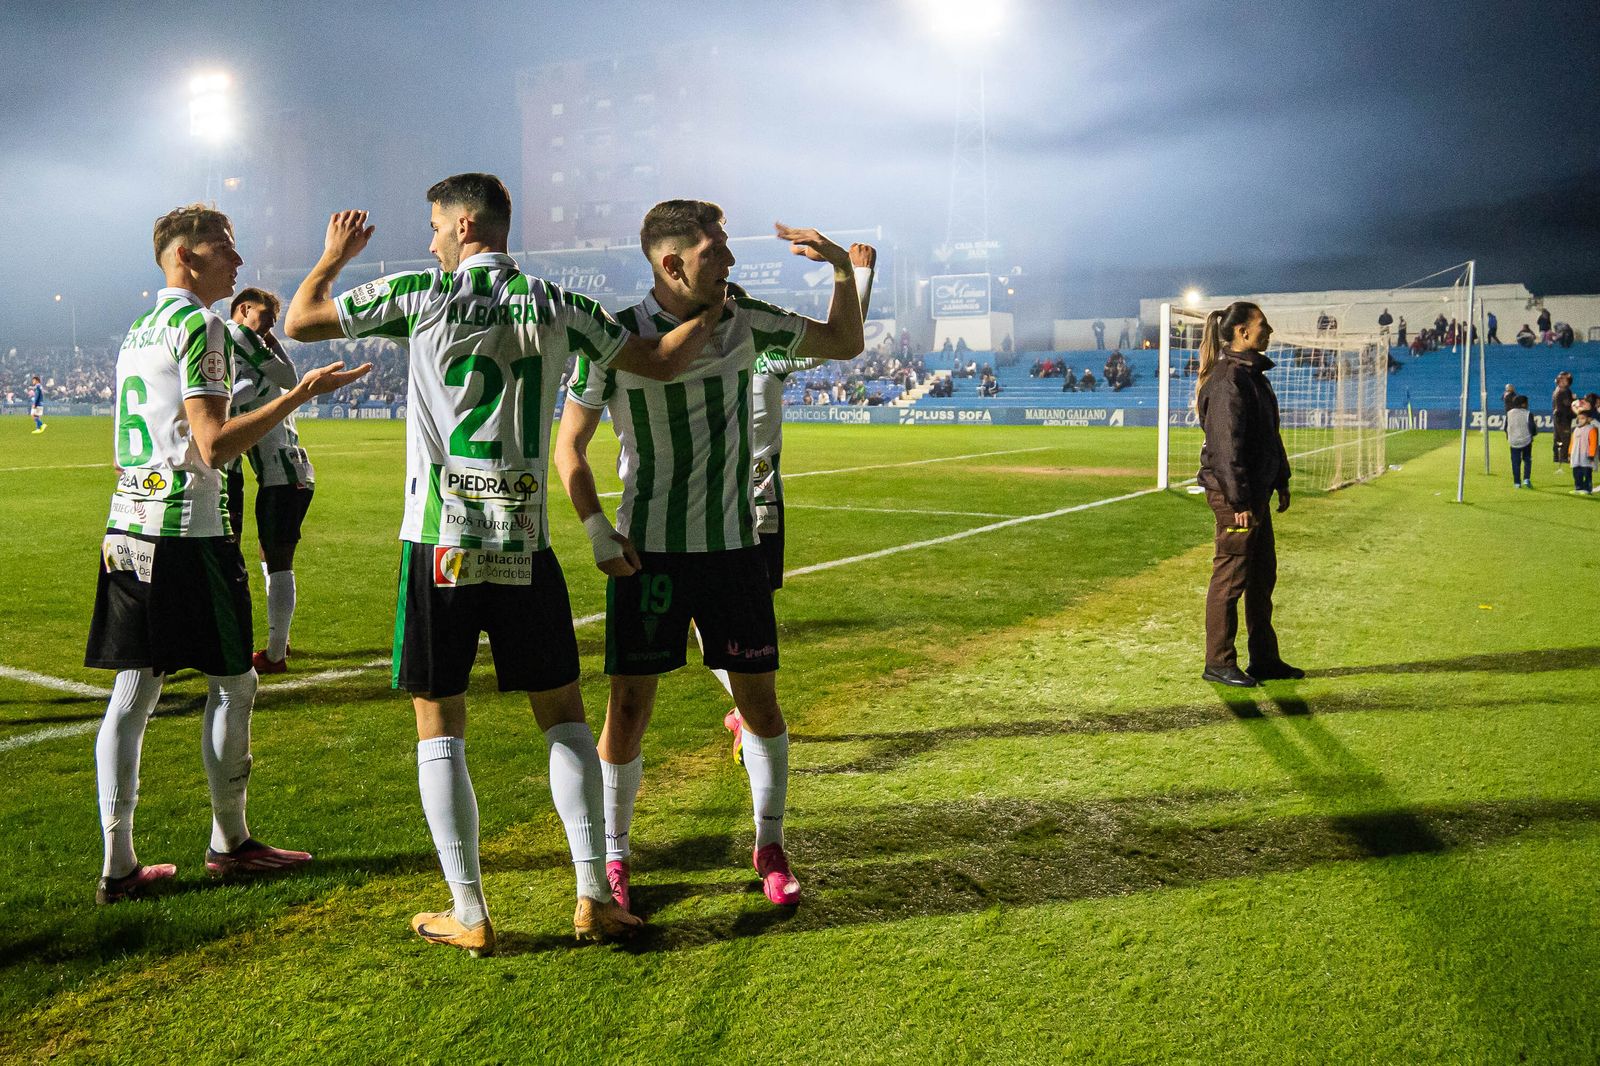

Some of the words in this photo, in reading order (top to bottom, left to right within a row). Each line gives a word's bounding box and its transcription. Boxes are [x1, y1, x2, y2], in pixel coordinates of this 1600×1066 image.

[561, 274, 606, 292] ALEJO
[447, 297, 551, 327] ALBARRÁN
[445, 355, 543, 460] 21
[915, 410, 955, 420] PLUSS
[1025, 408, 1065, 420] MARIANO
[1066, 408, 1107, 420] GALIANO
[118, 375, 154, 468] 6
[446, 514, 473, 527] DOS
[639, 573, 673, 615] 19
